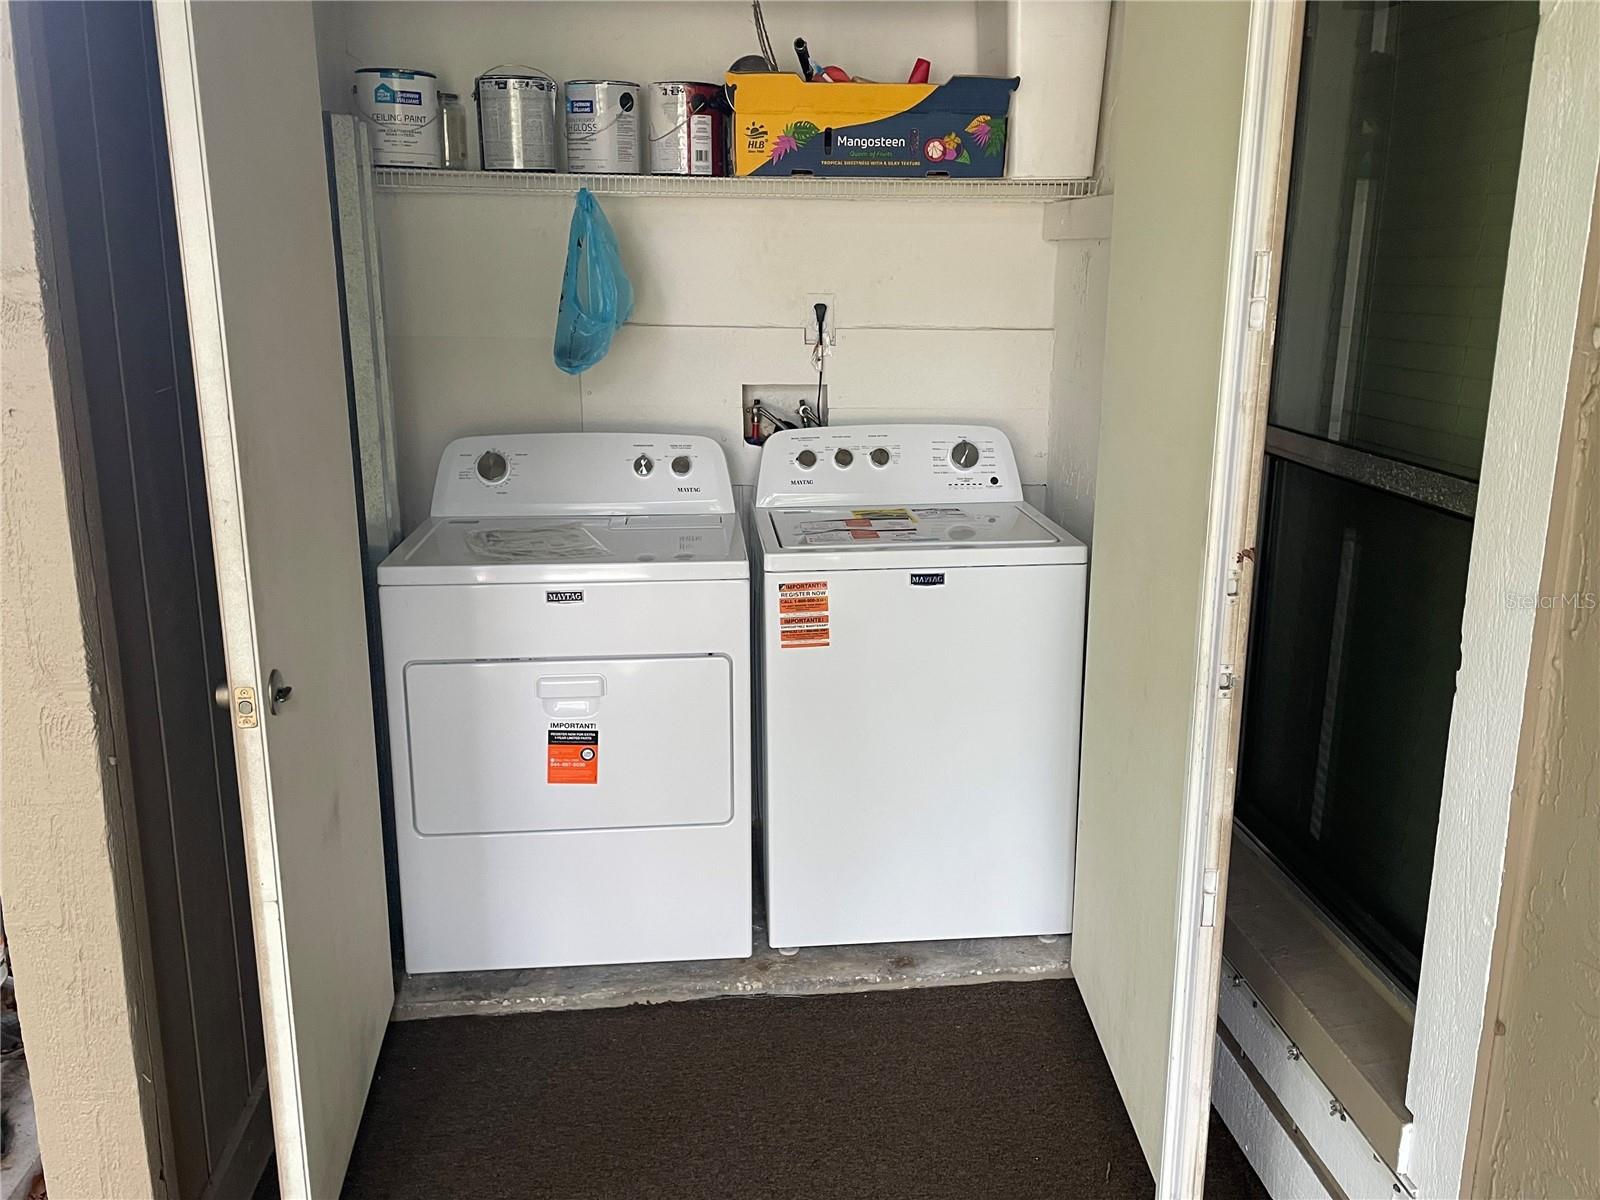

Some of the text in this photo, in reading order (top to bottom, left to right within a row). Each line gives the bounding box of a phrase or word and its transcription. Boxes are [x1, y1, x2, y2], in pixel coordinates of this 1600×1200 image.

[371, 113, 427, 124] CEILING PAINT
[747, 140, 765, 149] HLB
[837, 135, 906, 149] Mangosteen
[912, 575, 943, 584] MAYTAG
[548, 592, 581, 601] MAYTAG
